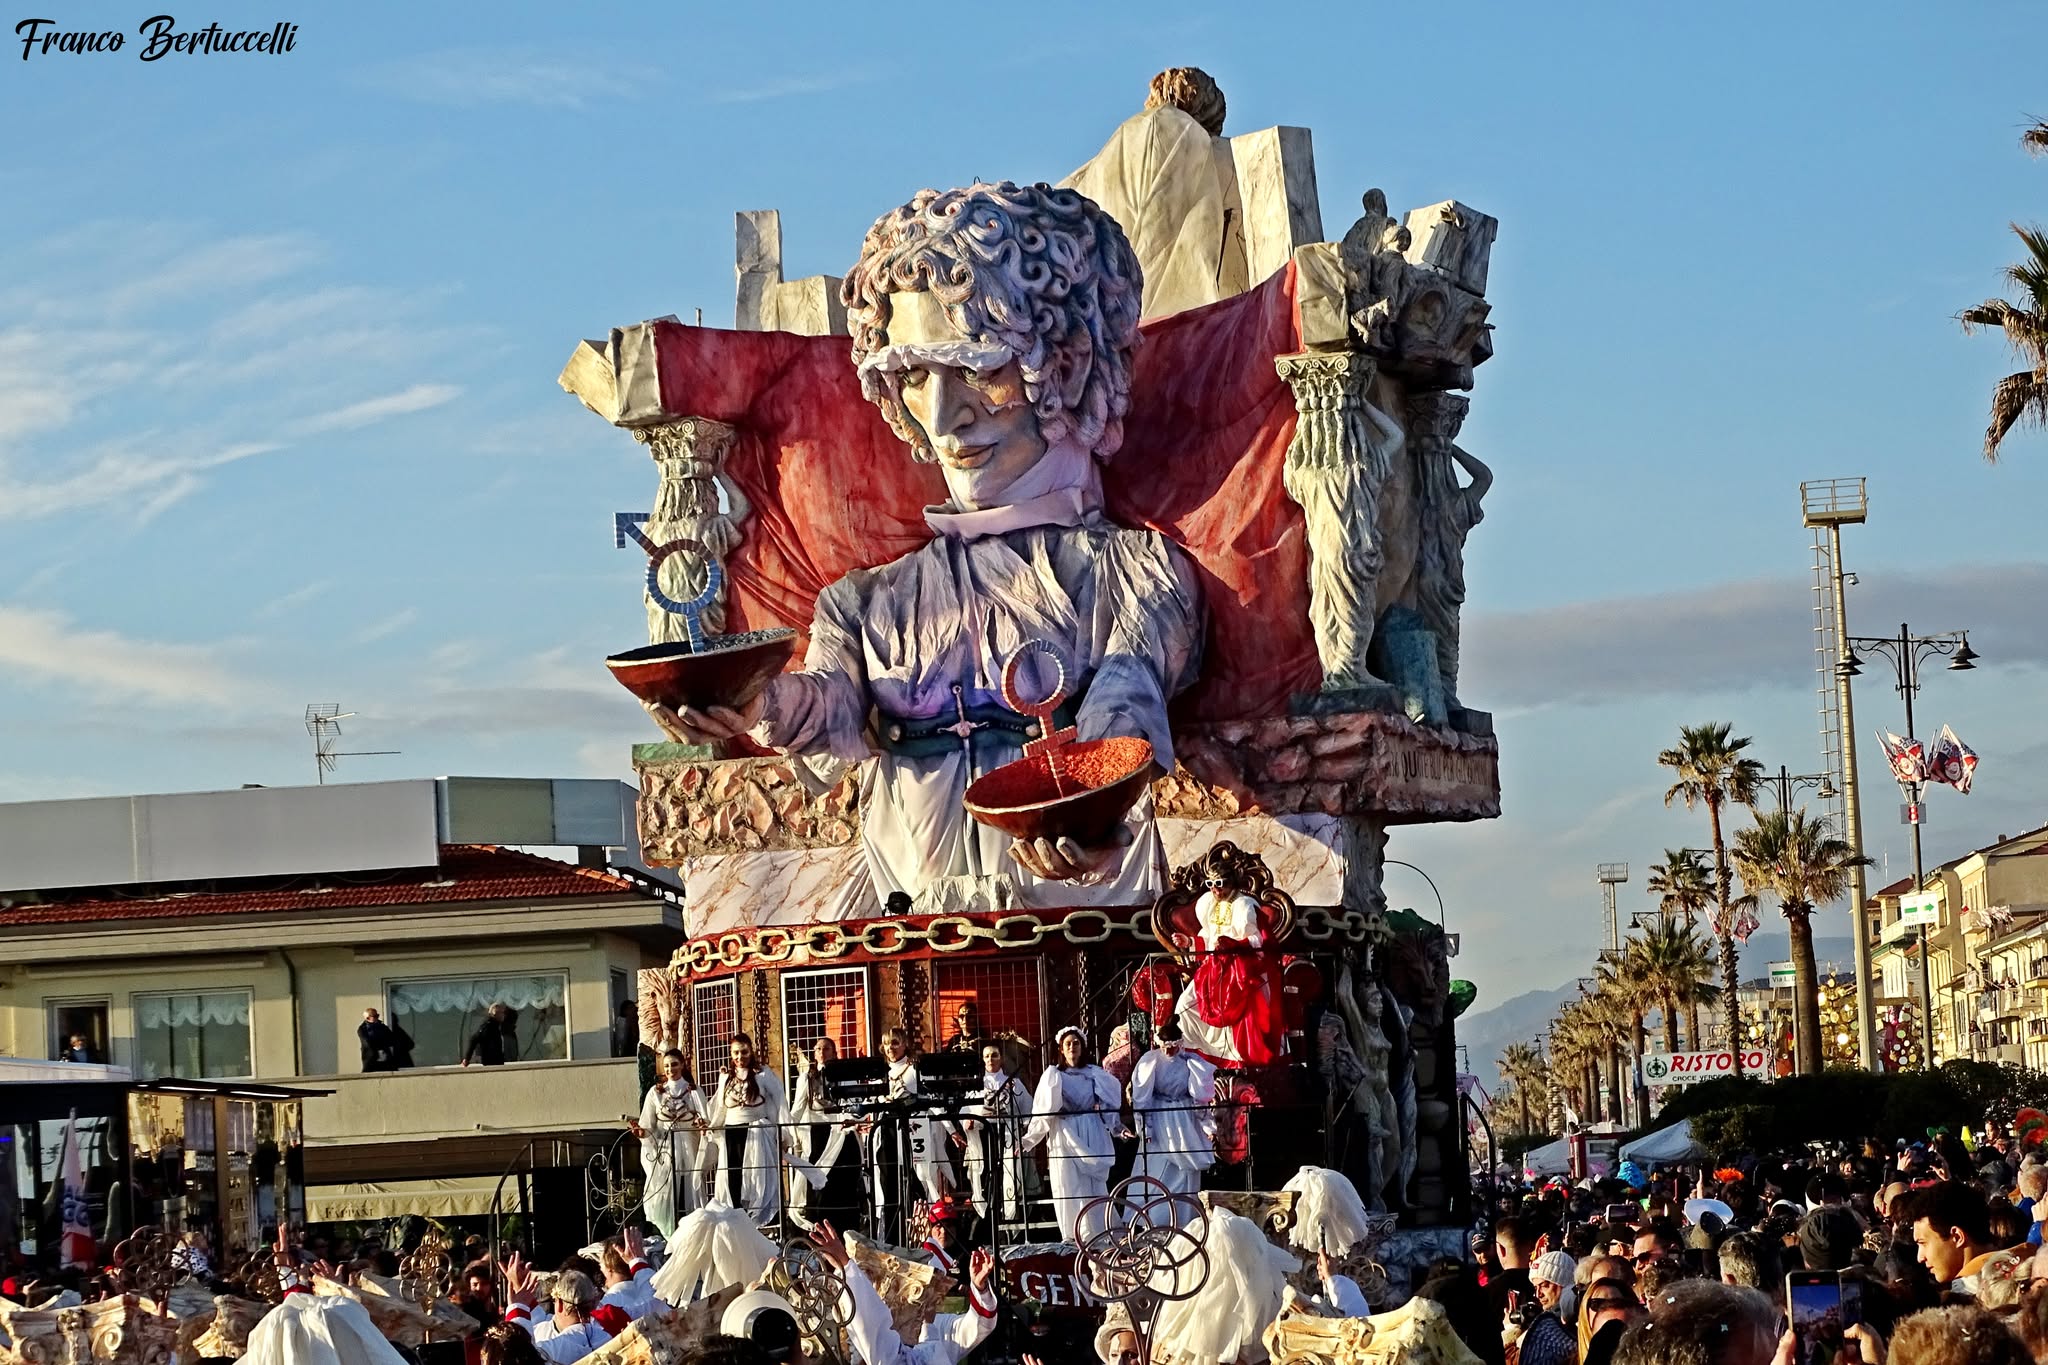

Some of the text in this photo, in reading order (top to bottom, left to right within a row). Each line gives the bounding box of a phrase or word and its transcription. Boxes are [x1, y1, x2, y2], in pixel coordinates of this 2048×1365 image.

[1670, 1052, 1763, 1072] RISTORO
[912, 1138, 926, 1154] 3
[1020, 1271, 1095, 1307] GEN
